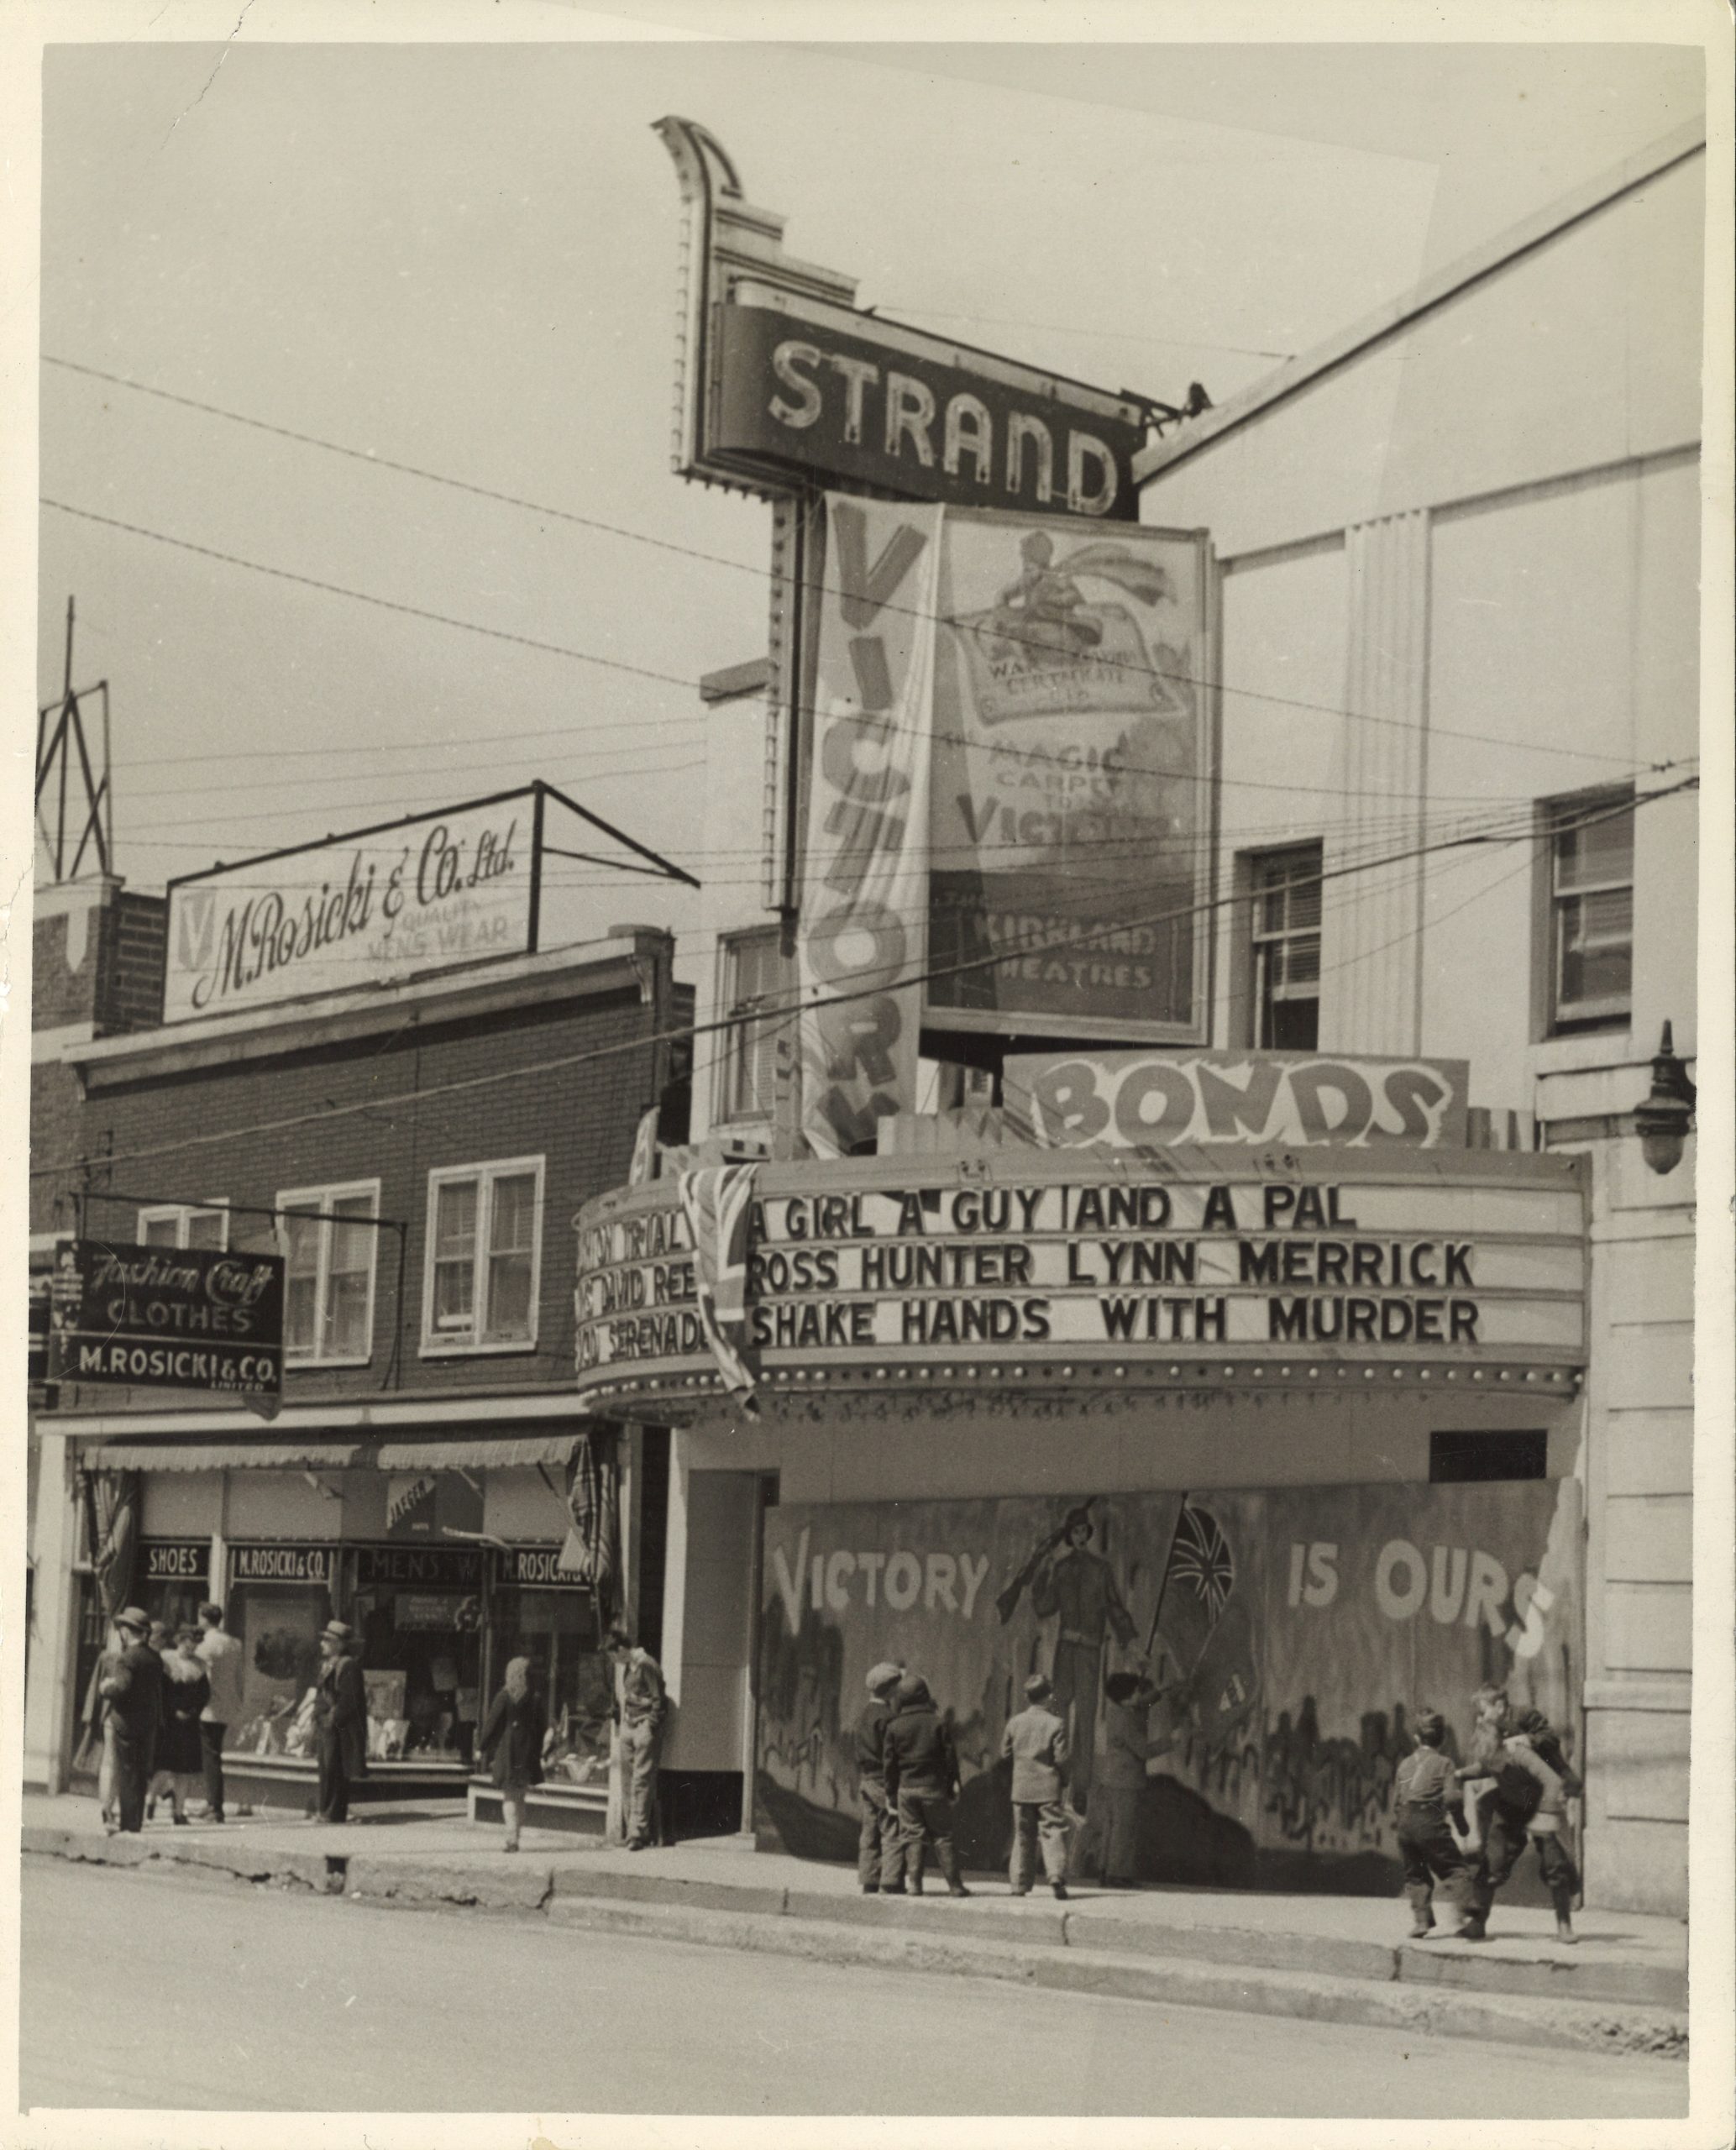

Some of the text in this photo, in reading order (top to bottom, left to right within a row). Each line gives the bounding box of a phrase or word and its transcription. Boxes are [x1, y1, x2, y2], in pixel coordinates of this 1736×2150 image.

[768, 340, 1118, 516] STRAND
[468, 818, 517, 889] Ltd.
[819, 502, 928, 1156] VICTORY
[1033, 1059, 1453, 1148] BONDS
[622, 1211, 683, 1261] TRIAL
[785, 1191, 876, 1240] GIRL
[898, 1189, 926, 1237] A
[951, 1188, 1044, 1235] GUY
[1073, 1185, 1172, 1231] AND
[1202, 1185, 1237, 1230] A
[1264, 1185, 1357, 1230] PAL
[90, 1253, 275, 1308] Fashion Craft
[749, 1240, 1475, 1298] ROSS HUNTER LYNN MERRICK
[107, 1299, 252, 1334] CLOTHES
[752, 1296, 1479, 1347] SHAKE HANDS WITH MURDER
[211, 1380, 265, 1392] LIMITED
[149, 1547, 198, 1575] SHOES
[773, 1526, 1555, 1659] VICTORY IS OURS
